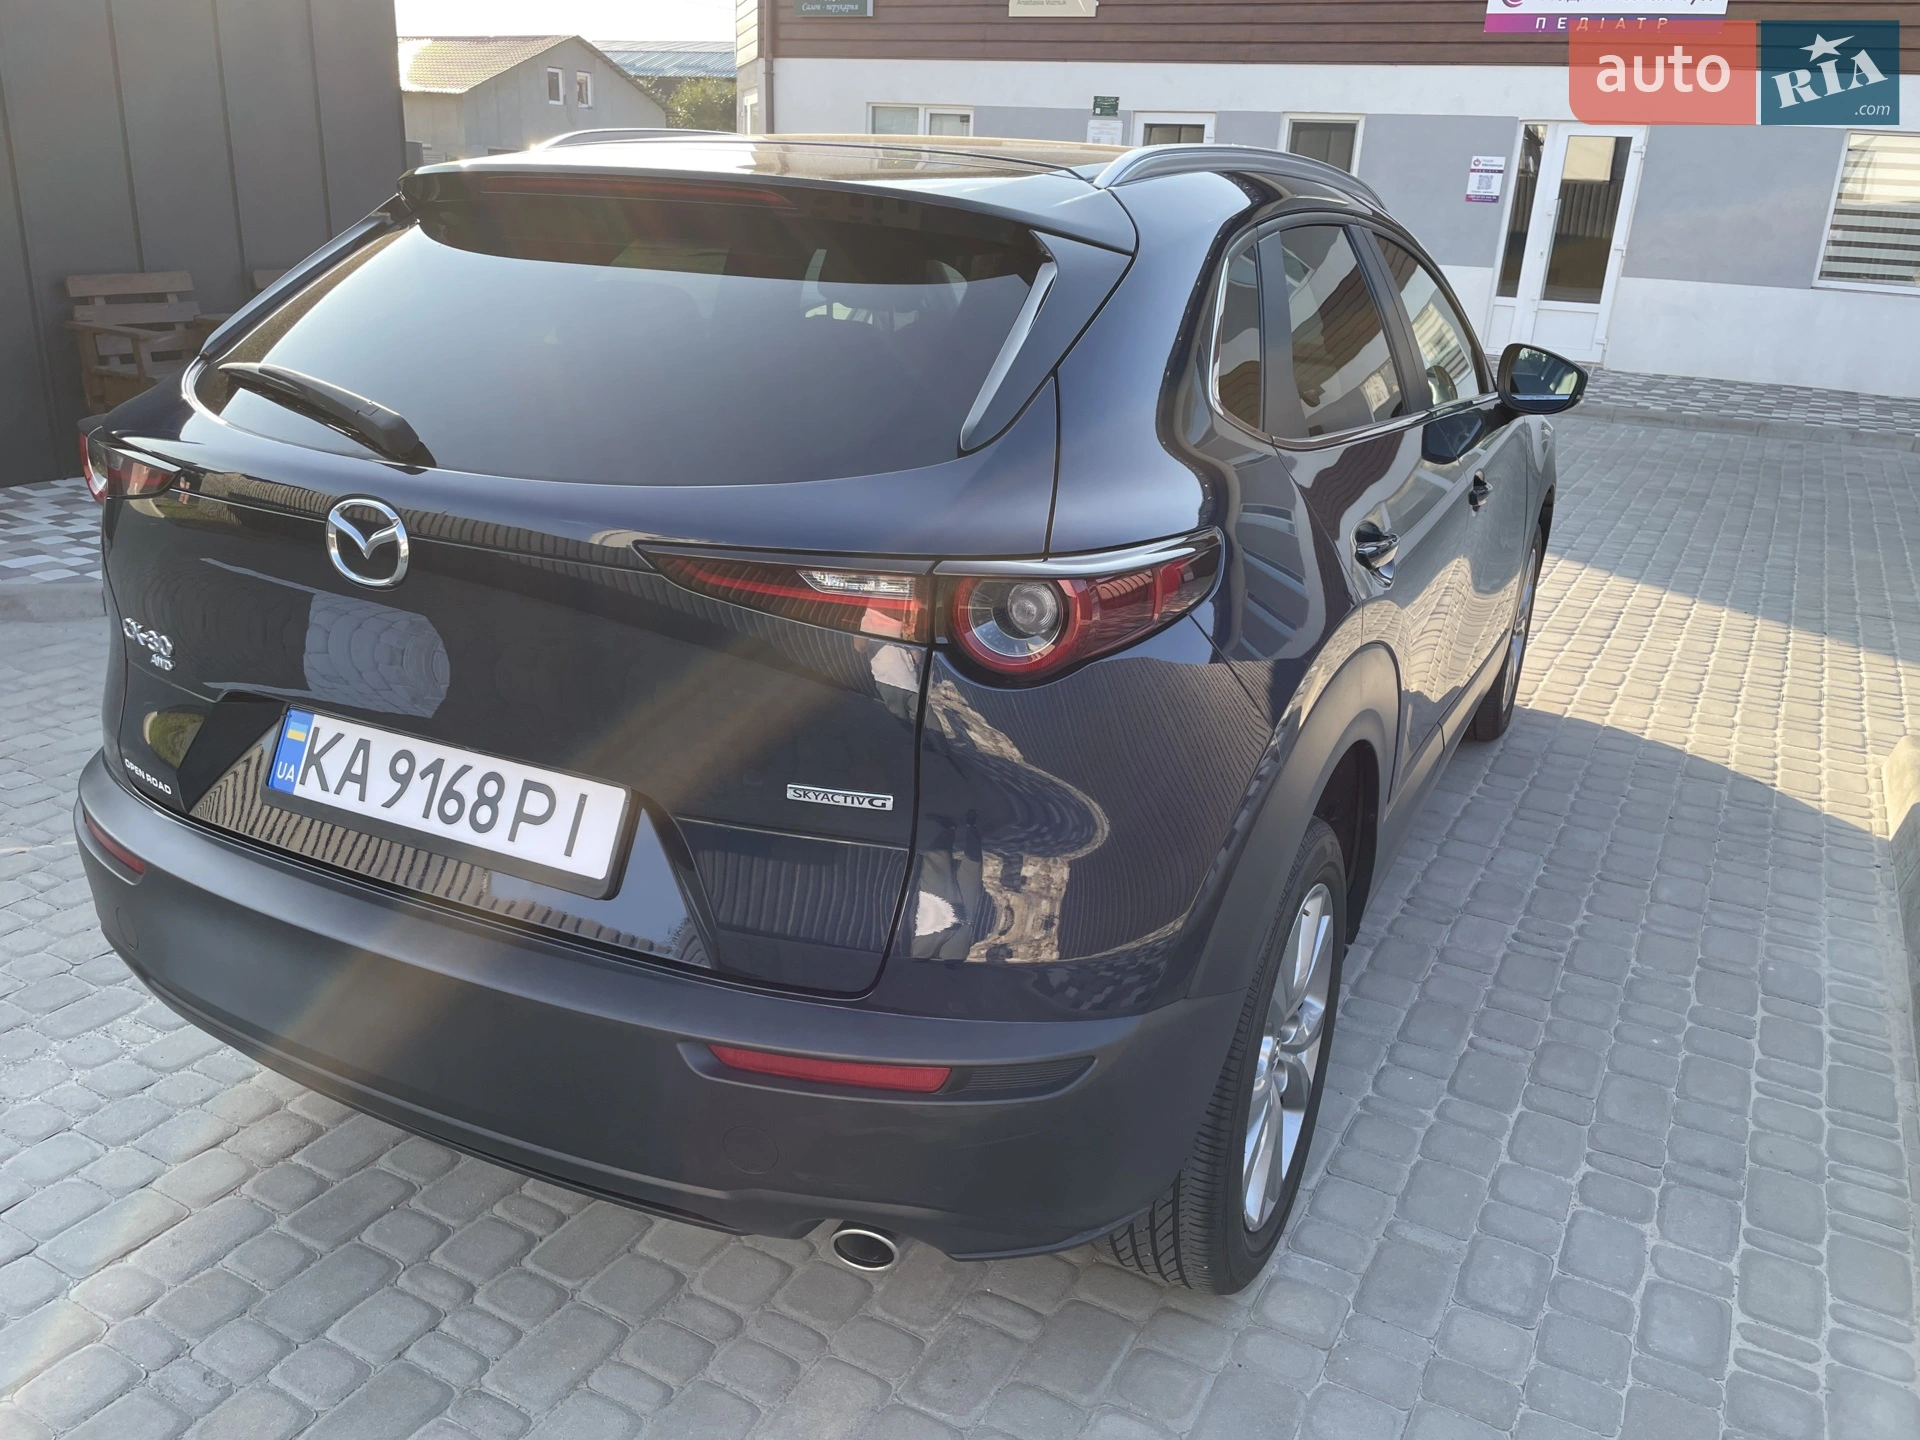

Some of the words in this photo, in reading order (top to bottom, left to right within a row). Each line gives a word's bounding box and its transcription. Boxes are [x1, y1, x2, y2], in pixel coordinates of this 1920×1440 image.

[1535, 17, 1668, 31] ПЕДІАТР
[123, 617, 174, 658] CX-30
[151, 653, 174, 671] AWD
[124, 758, 146, 780] OPEN
[145, 773, 172, 795] ROAD
[276, 761, 295, 783] UA
